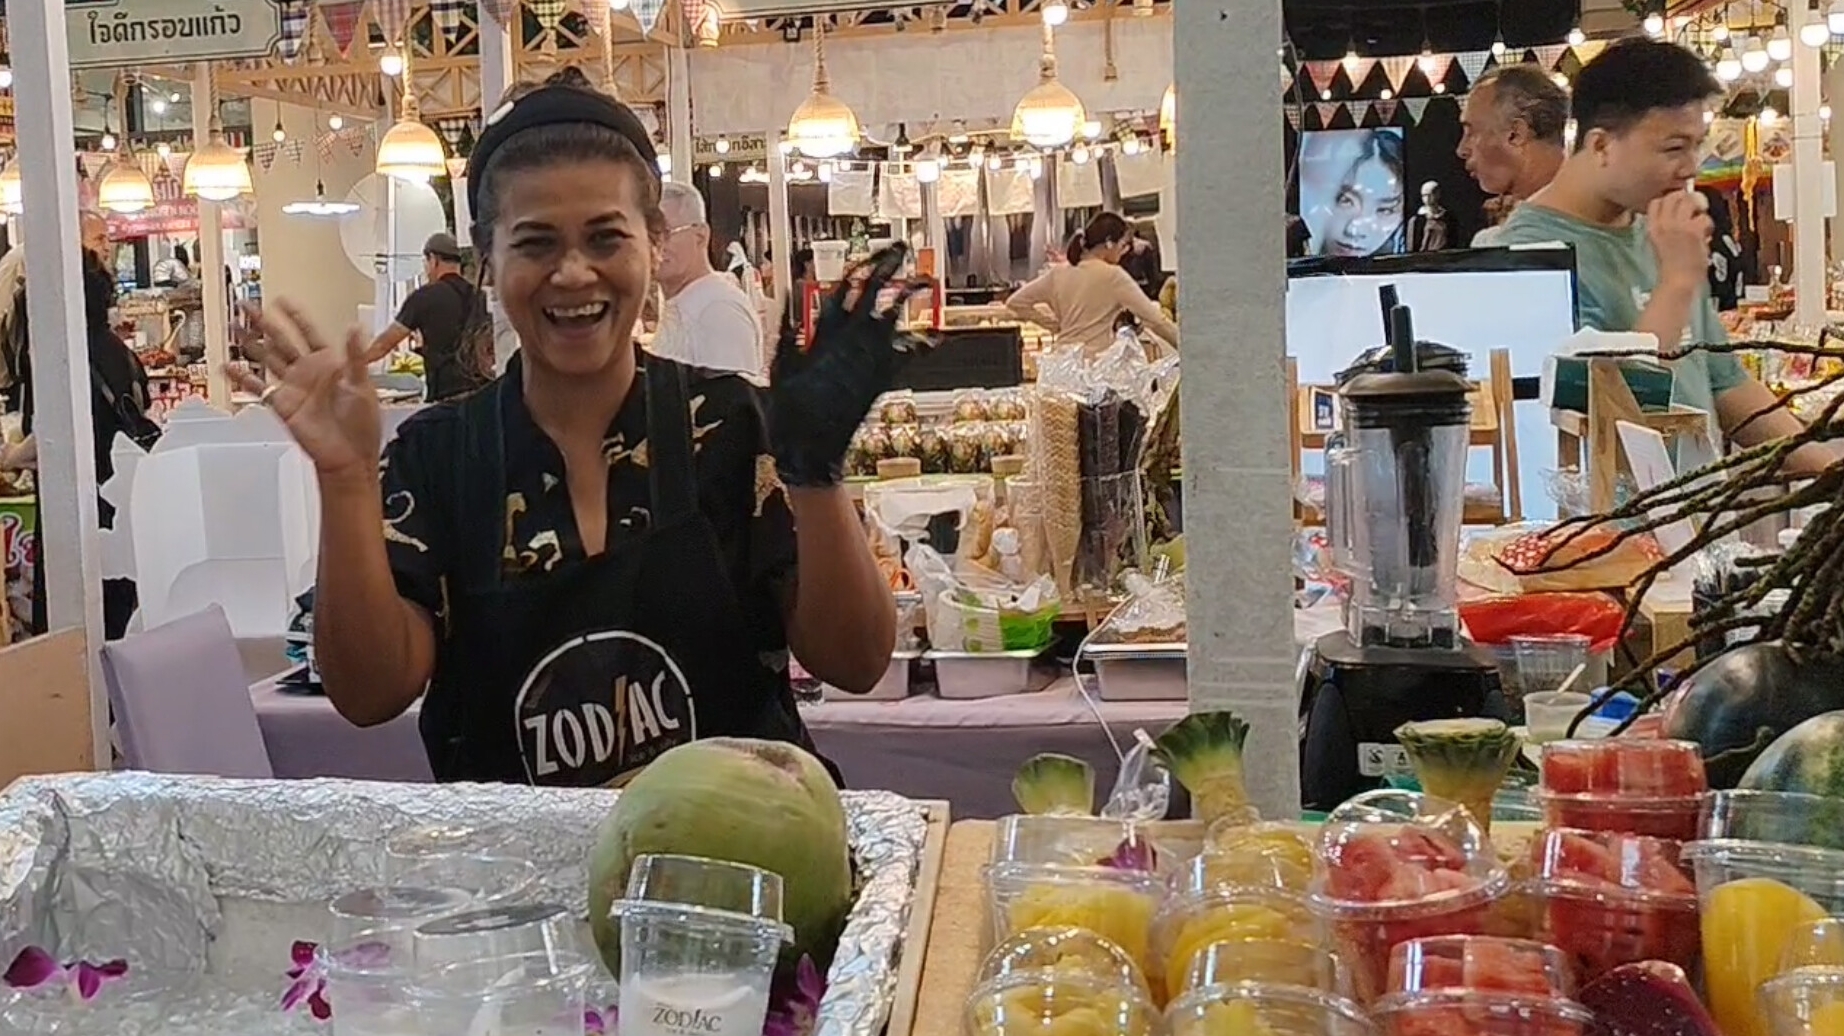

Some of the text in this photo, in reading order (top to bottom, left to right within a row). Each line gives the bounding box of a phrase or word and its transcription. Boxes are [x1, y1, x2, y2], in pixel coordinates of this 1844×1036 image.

[87, 6, 241, 44] ใจดีกรอบแก้ว
[524, 670, 680, 777] ZODIAC
[653, 1002, 722, 1032] ZODIAC
